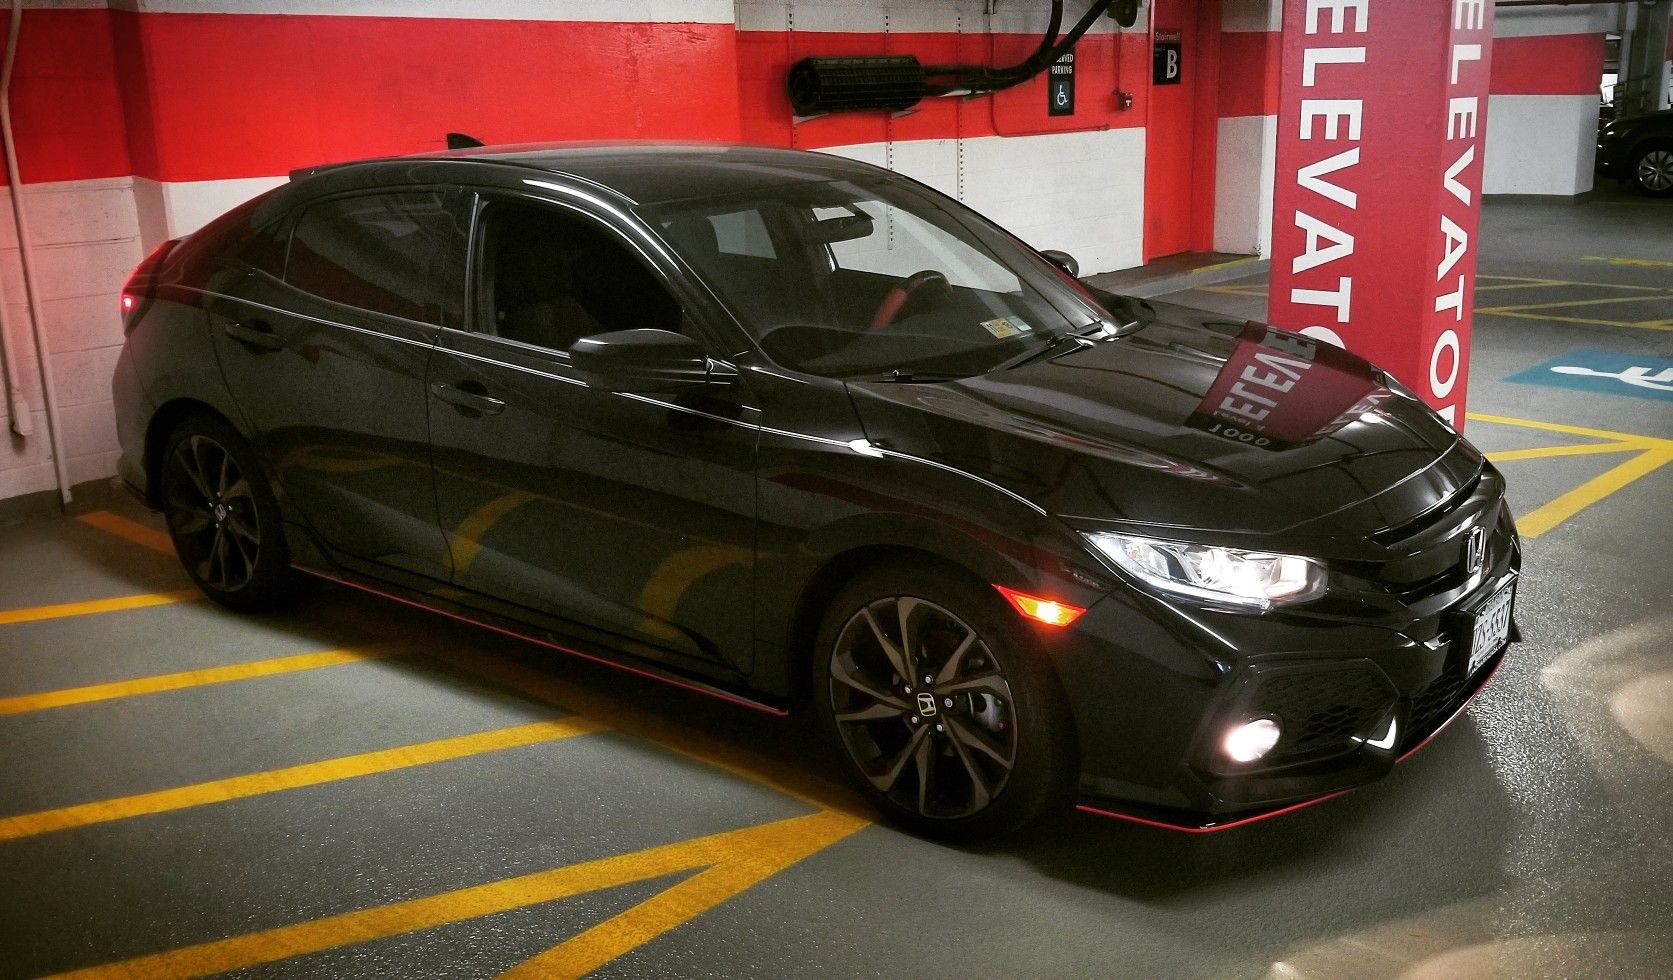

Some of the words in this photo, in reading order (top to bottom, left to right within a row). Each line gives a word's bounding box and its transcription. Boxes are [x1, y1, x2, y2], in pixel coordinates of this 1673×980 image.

[1056, 53, 1074, 63] ERVED
[1166, 49, 1178, 79] B
[1051, 65, 1073, 75] PARKING
